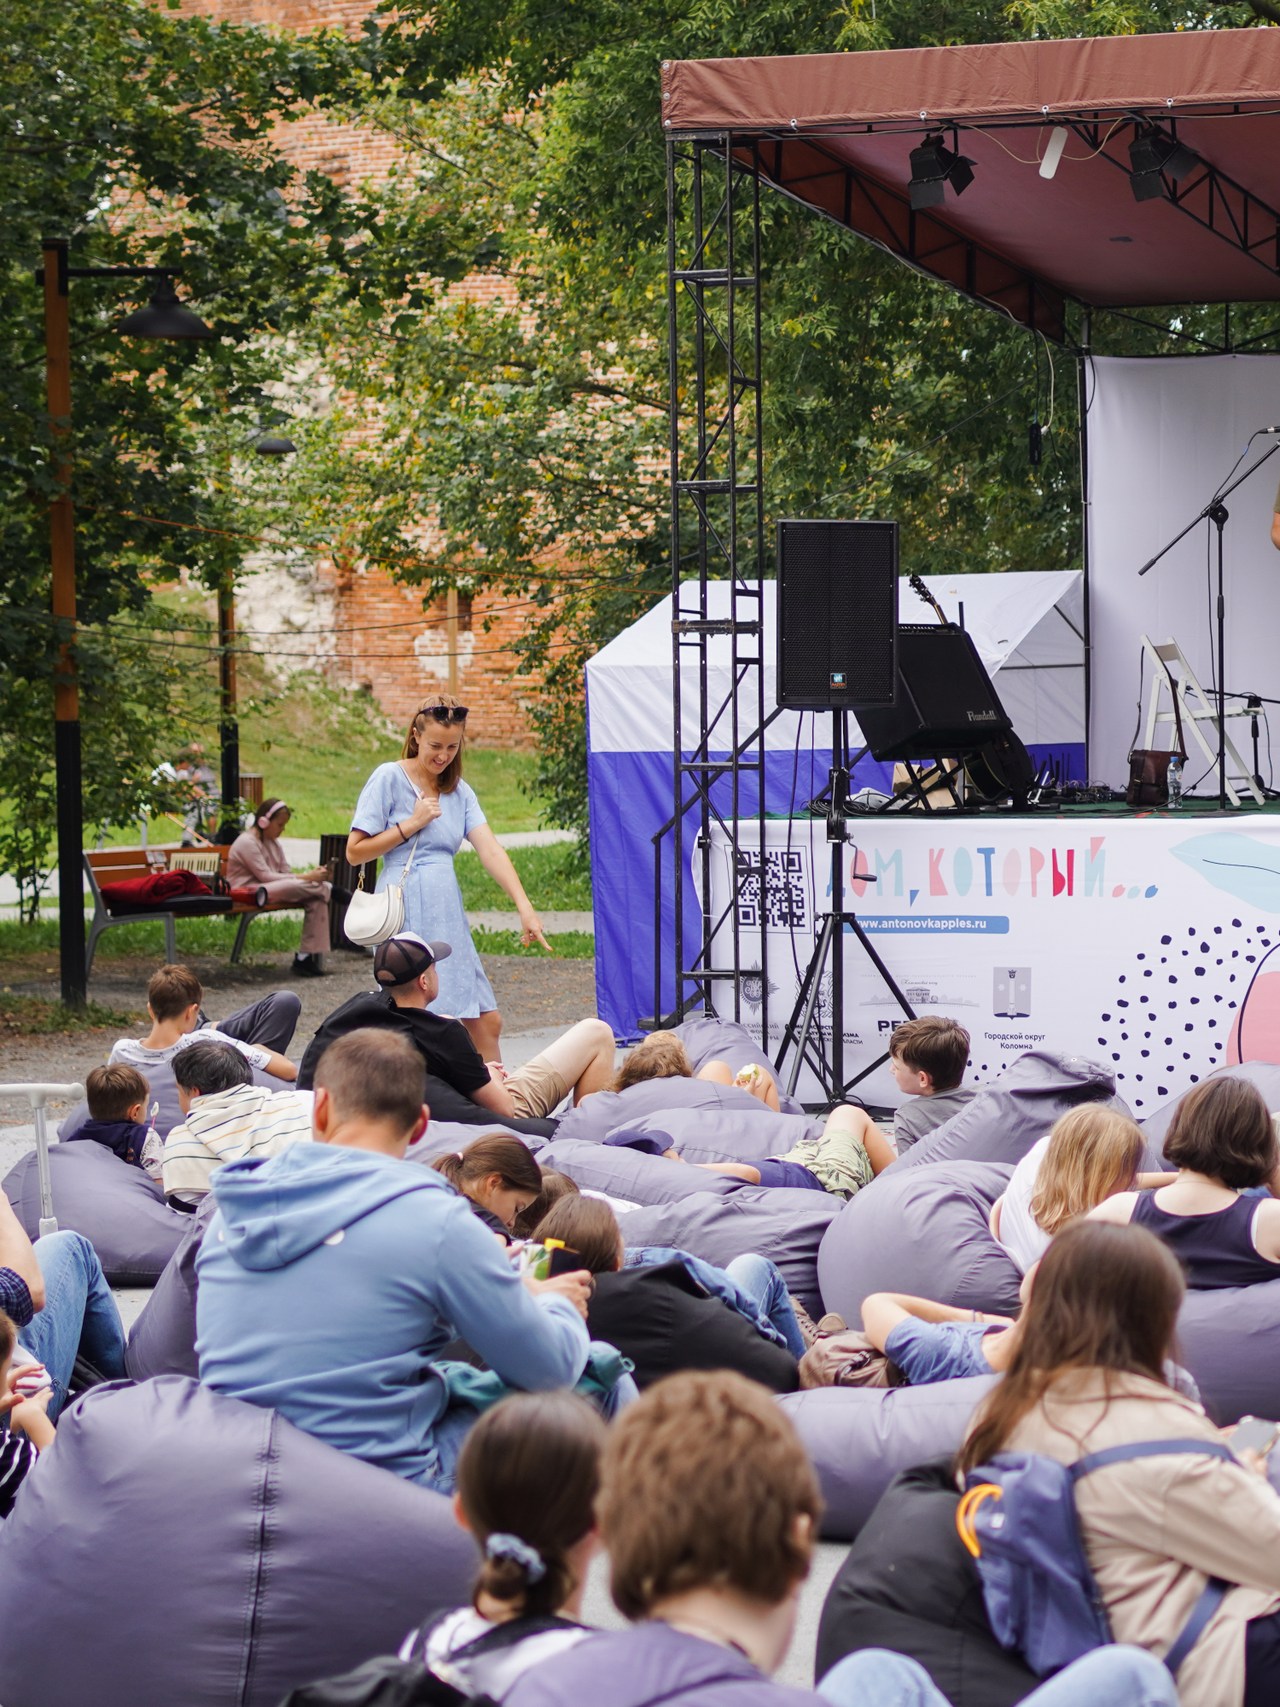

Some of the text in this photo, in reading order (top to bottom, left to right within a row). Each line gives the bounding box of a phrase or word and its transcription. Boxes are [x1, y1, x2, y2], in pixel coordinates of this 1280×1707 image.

[984, 1032, 1046, 1042] Городской округ
[1000, 1042, 1033, 1050] Коломна
